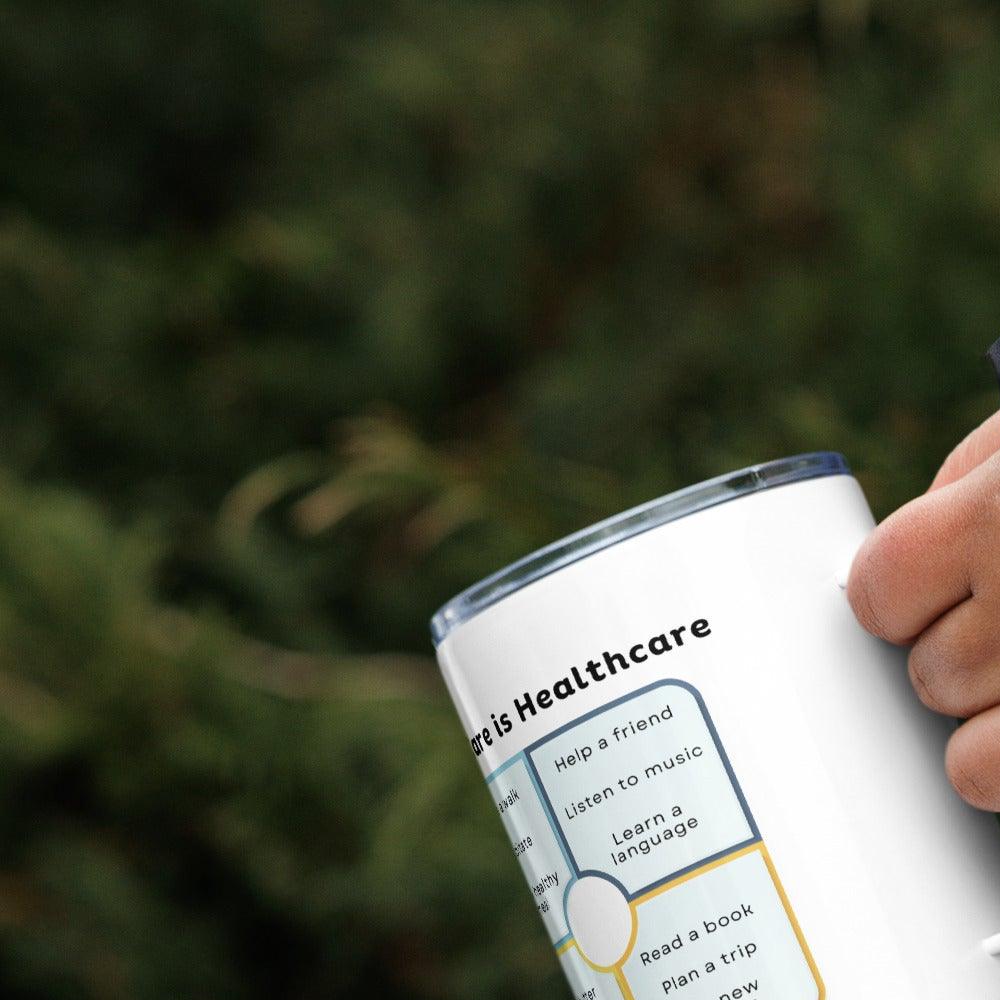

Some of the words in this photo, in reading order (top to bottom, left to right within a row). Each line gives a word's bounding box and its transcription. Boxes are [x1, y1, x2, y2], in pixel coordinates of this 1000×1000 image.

[491, 713, 512, 737] is
[513, 618, 712, 722] Healthcare
[554, 745, 593, 773] Help
[598, 738, 609, 750] a
[612, 705, 674, 742] friend
[565, 787, 614, 820] Listen
[618, 775, 638, 790] to
[644, 746, 703, 779] music
[611, 817, 699, 866] language
[612, 813, 665, 846] Learn
[671, 805, 683, 817] a
[640, 934, 684, 966] Read
[688, 930, 700, 941] a
[703, 904, 754, 933] book
[662, 969, 700, 994] Plan
[705, 962, 716, 973] a
[720, 942, 757, 965] trip
